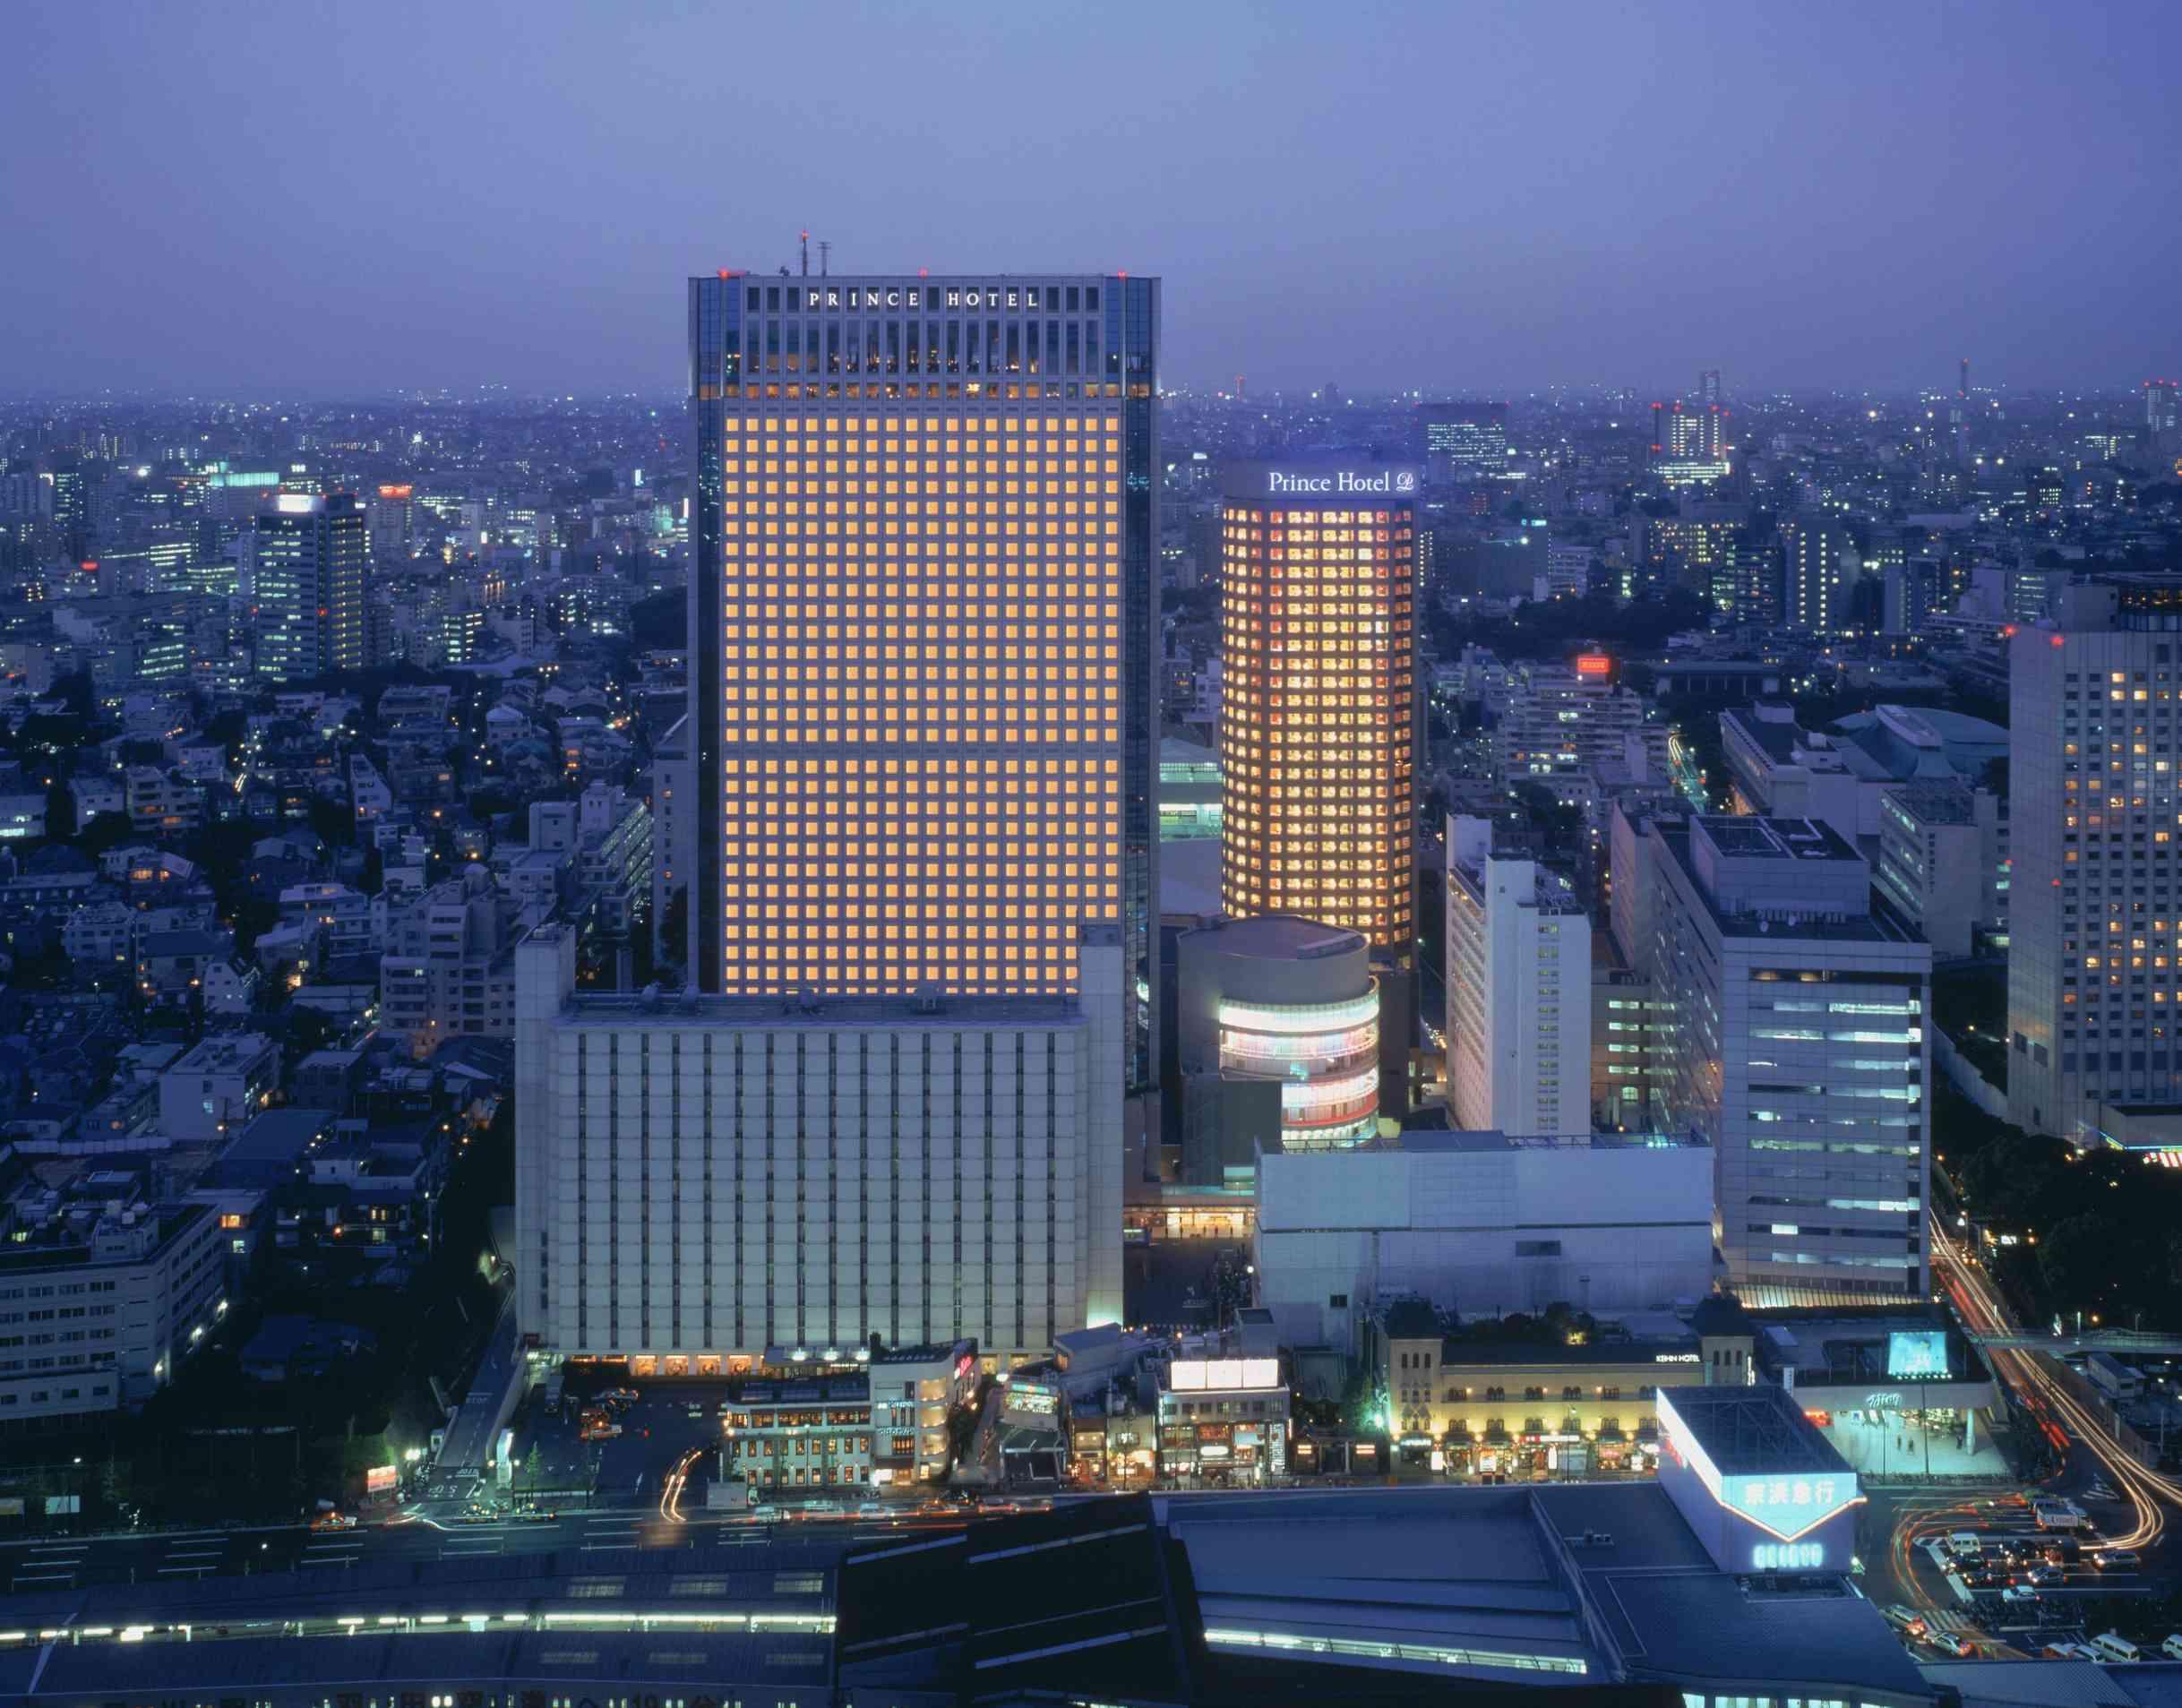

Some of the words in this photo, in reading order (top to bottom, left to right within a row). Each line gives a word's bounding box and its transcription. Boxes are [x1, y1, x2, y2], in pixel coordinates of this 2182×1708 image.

[809, 292, 919, 307] PRINCE
[947, 292, 1039, 307] HOTEL
[1268, 471, 1332, 493] Prince
[1337, 471, 1390, 493] Hotel
